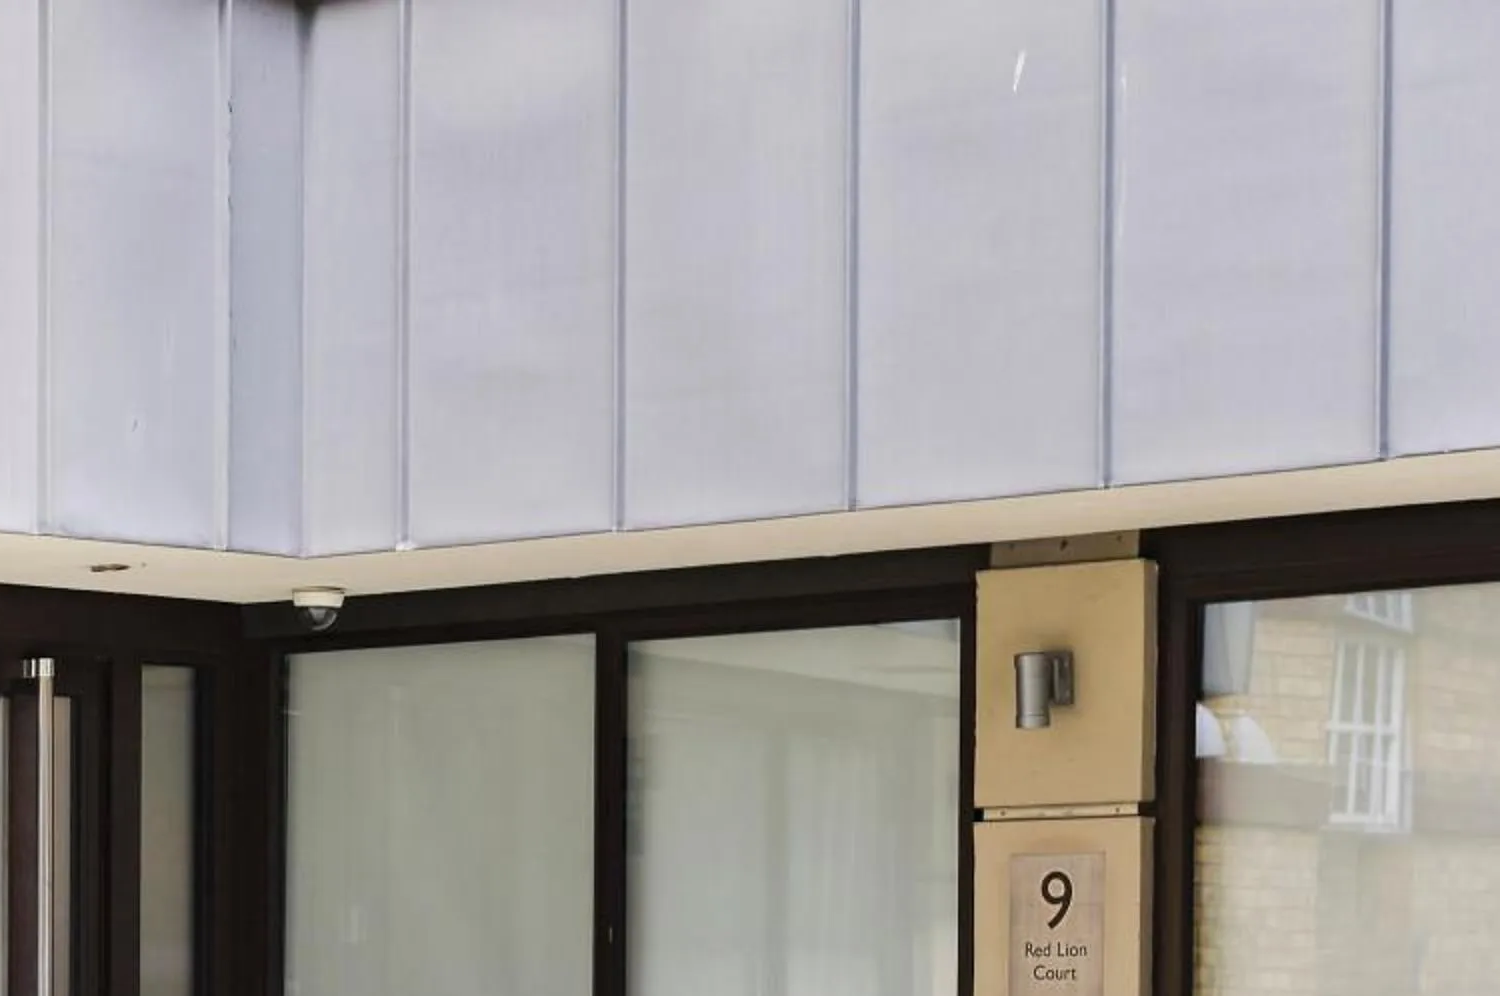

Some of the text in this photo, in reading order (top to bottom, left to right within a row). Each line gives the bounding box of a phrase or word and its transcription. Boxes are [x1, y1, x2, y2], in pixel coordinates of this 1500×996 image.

[1041, 870, 1073, 929] 9
[1024, 941, 1088, 957] Red Lion
[1033, 965, 1077, 981] Court
